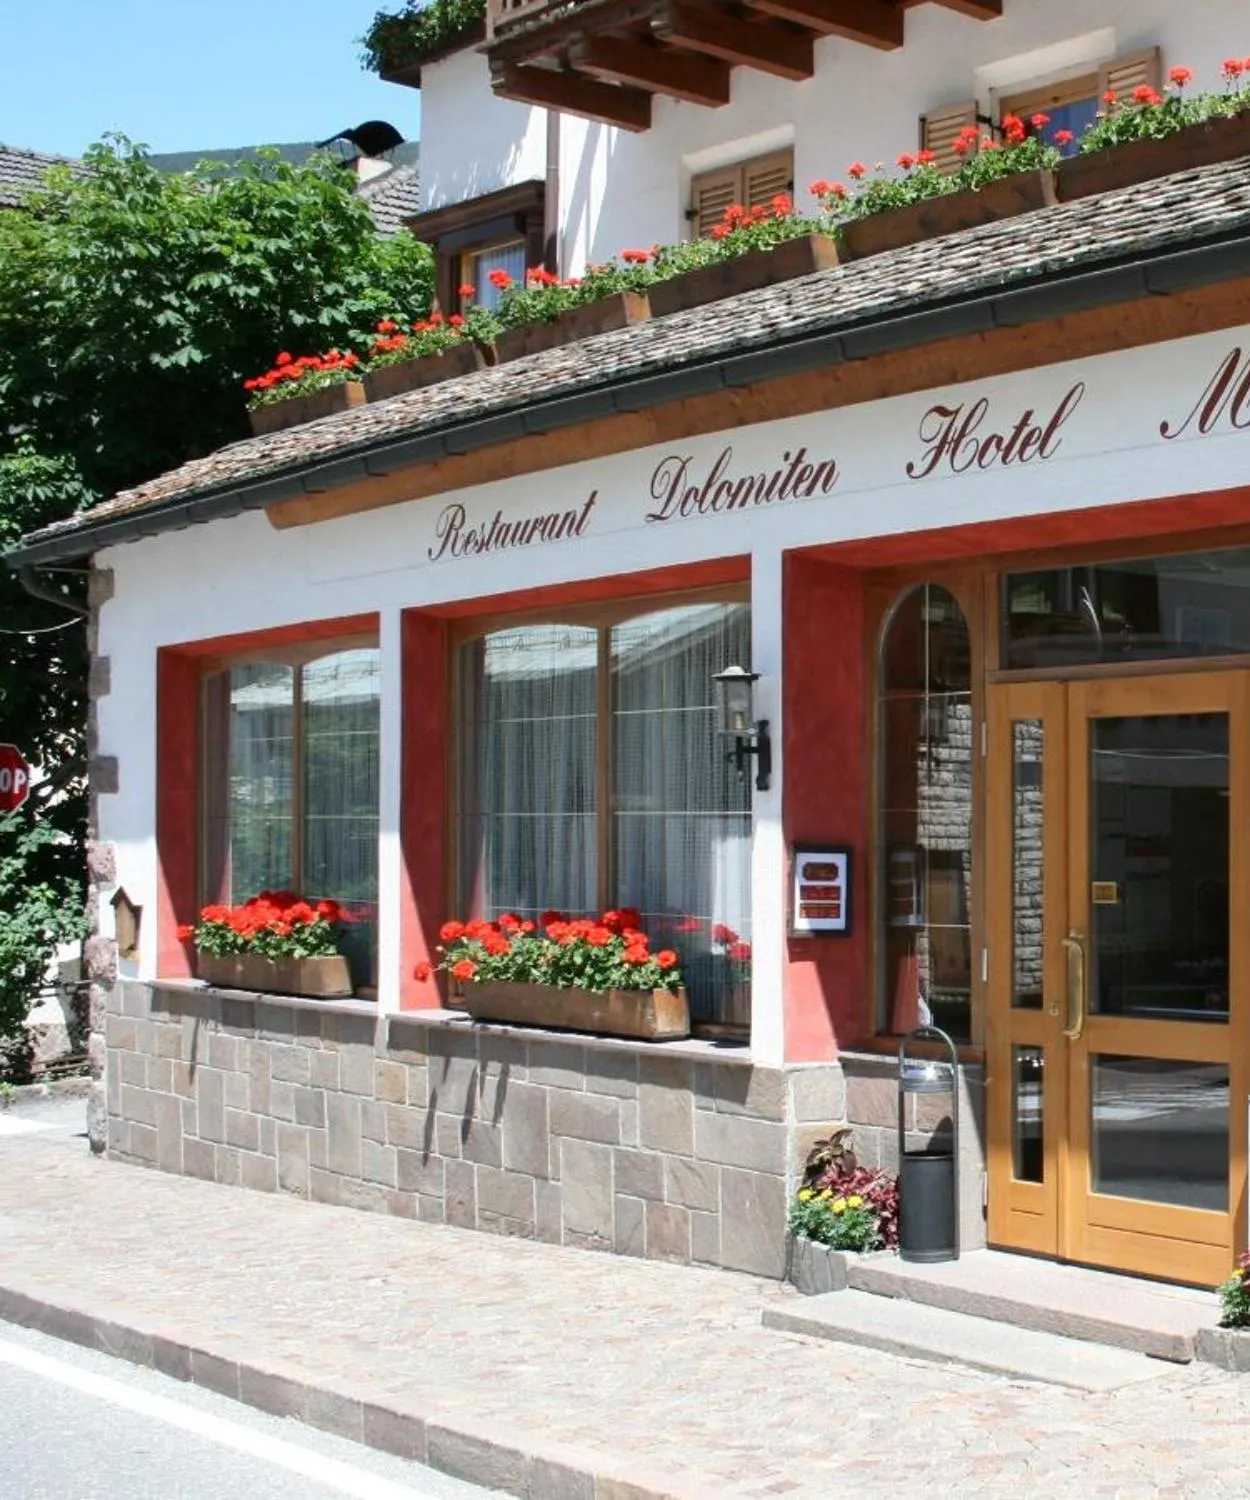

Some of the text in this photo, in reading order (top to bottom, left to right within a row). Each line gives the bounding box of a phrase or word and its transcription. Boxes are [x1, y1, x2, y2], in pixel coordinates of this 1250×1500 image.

[427, 489, 599, 562] Restaurant
[643, 445, 841, 524] Dolomiten
[905, 381, 1086, 480] Hotel
